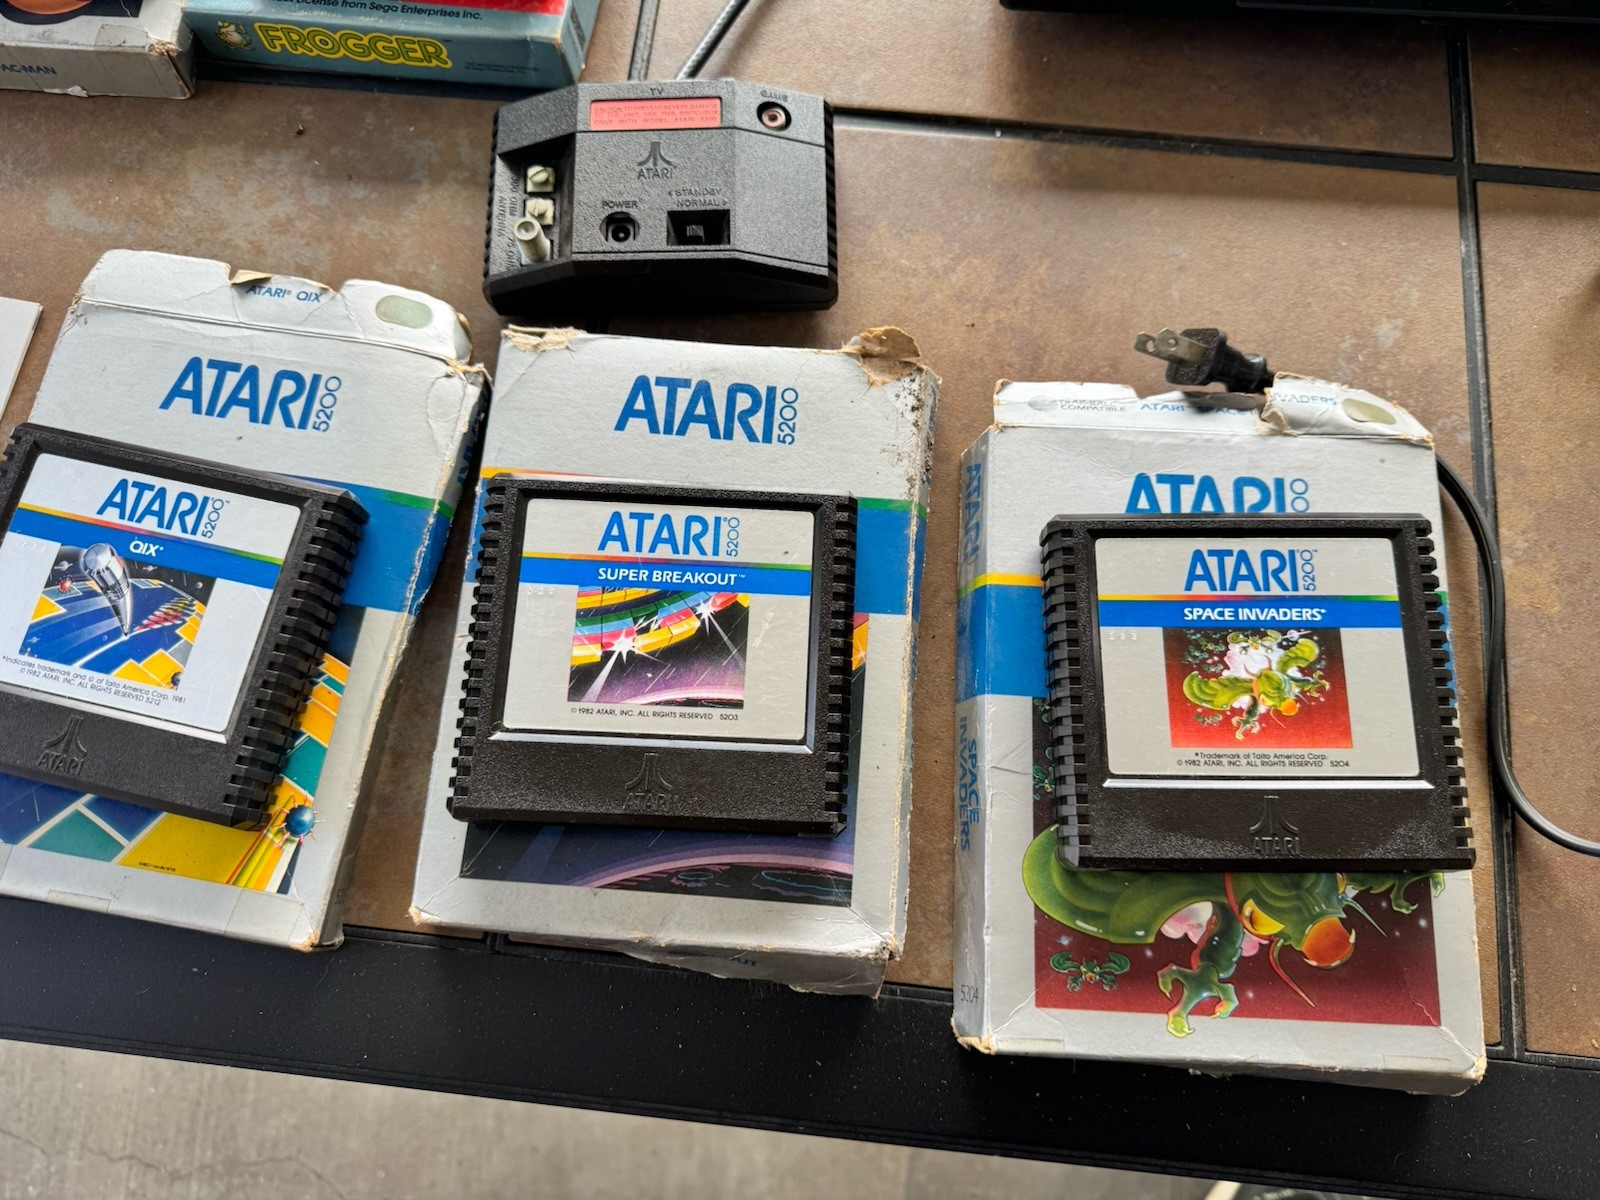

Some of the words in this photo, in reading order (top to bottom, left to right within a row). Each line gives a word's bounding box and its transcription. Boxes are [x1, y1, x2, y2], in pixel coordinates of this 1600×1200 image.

[341, 0, 367, 9] from
[369, 2, 398, 13] Sega
[401, 4, 461, 17] Enterprises
[462, 10, 483, 20] Inc.
[256, 23, 452, 69] FROGGER
[0, 64, 57, 74] AC-MAN
[637, 168, 673, 180] ATARI
[602, 200, 638, 209] POWER
[677, 199, 720, 208] NORMAL
[296, 291, 323, 302] QIX
[159, 356, 323, 430] ATARI
[312, 376, 342, 432] 5200
[614, 375, 776, 445] ATARI
[776, 387, 800, 446] 5200
[1141, 403, 1185, 412] ATARI
[96, 478, 210, 536] ATARI
[201, 498, 224, 539] 5200
[597, 510, 722, 557] ATARI
[726, 517, 740, 557] 5200
[598, 567, 649, 582] SUPER
[1184, 549, 1299, 592] ATARI
[1300, 549, 1316, 591] 5200
[1183, 607, 1235, 621] SPACE
[26, 668, 41, 678] 1982
[62, 676, 76, 686] INC.
[77, 680, 90, 688] ALL
[90, 683, 113, 694] RIGHTS
[114, 688, 144, 702] RESERVED
[145, 696, 161, 706] 5212
[37, 662, 71, 677] trademark
[72, 671, 87, 681] and
[104, 678, 121, 689] Taito
[121, 683, 150, 696] America
[151, 689, 170, 702] Corp.
[172, 694, 187, 704] 1981
[578, 707, 594, 715] 1982
[652, 711, 677, 719] RIGHTS
[679, 712, 713, 720] RESERVED
[719, 713, 739, 721] 5203
[36, 749, 84, 776] ATARI
[1184, 759, 1201, 767] 1982
[1288, 760, 1323, 768] RESERVED
[1243, 752, 1251, 760] of
[1252, 752, 1271, 760] Taito
[1273, 752, 1305, 760] America
[1307, 753, 1329, 761] Corp.
[958, 716, 971, 852] INVADERS
[968, 738, 980, 824] SPACE
[622, 792, 670, 811] ATARI
[1252, 836, 1300, 854] ATARI
[961, 984, 979, 1004] 5204
